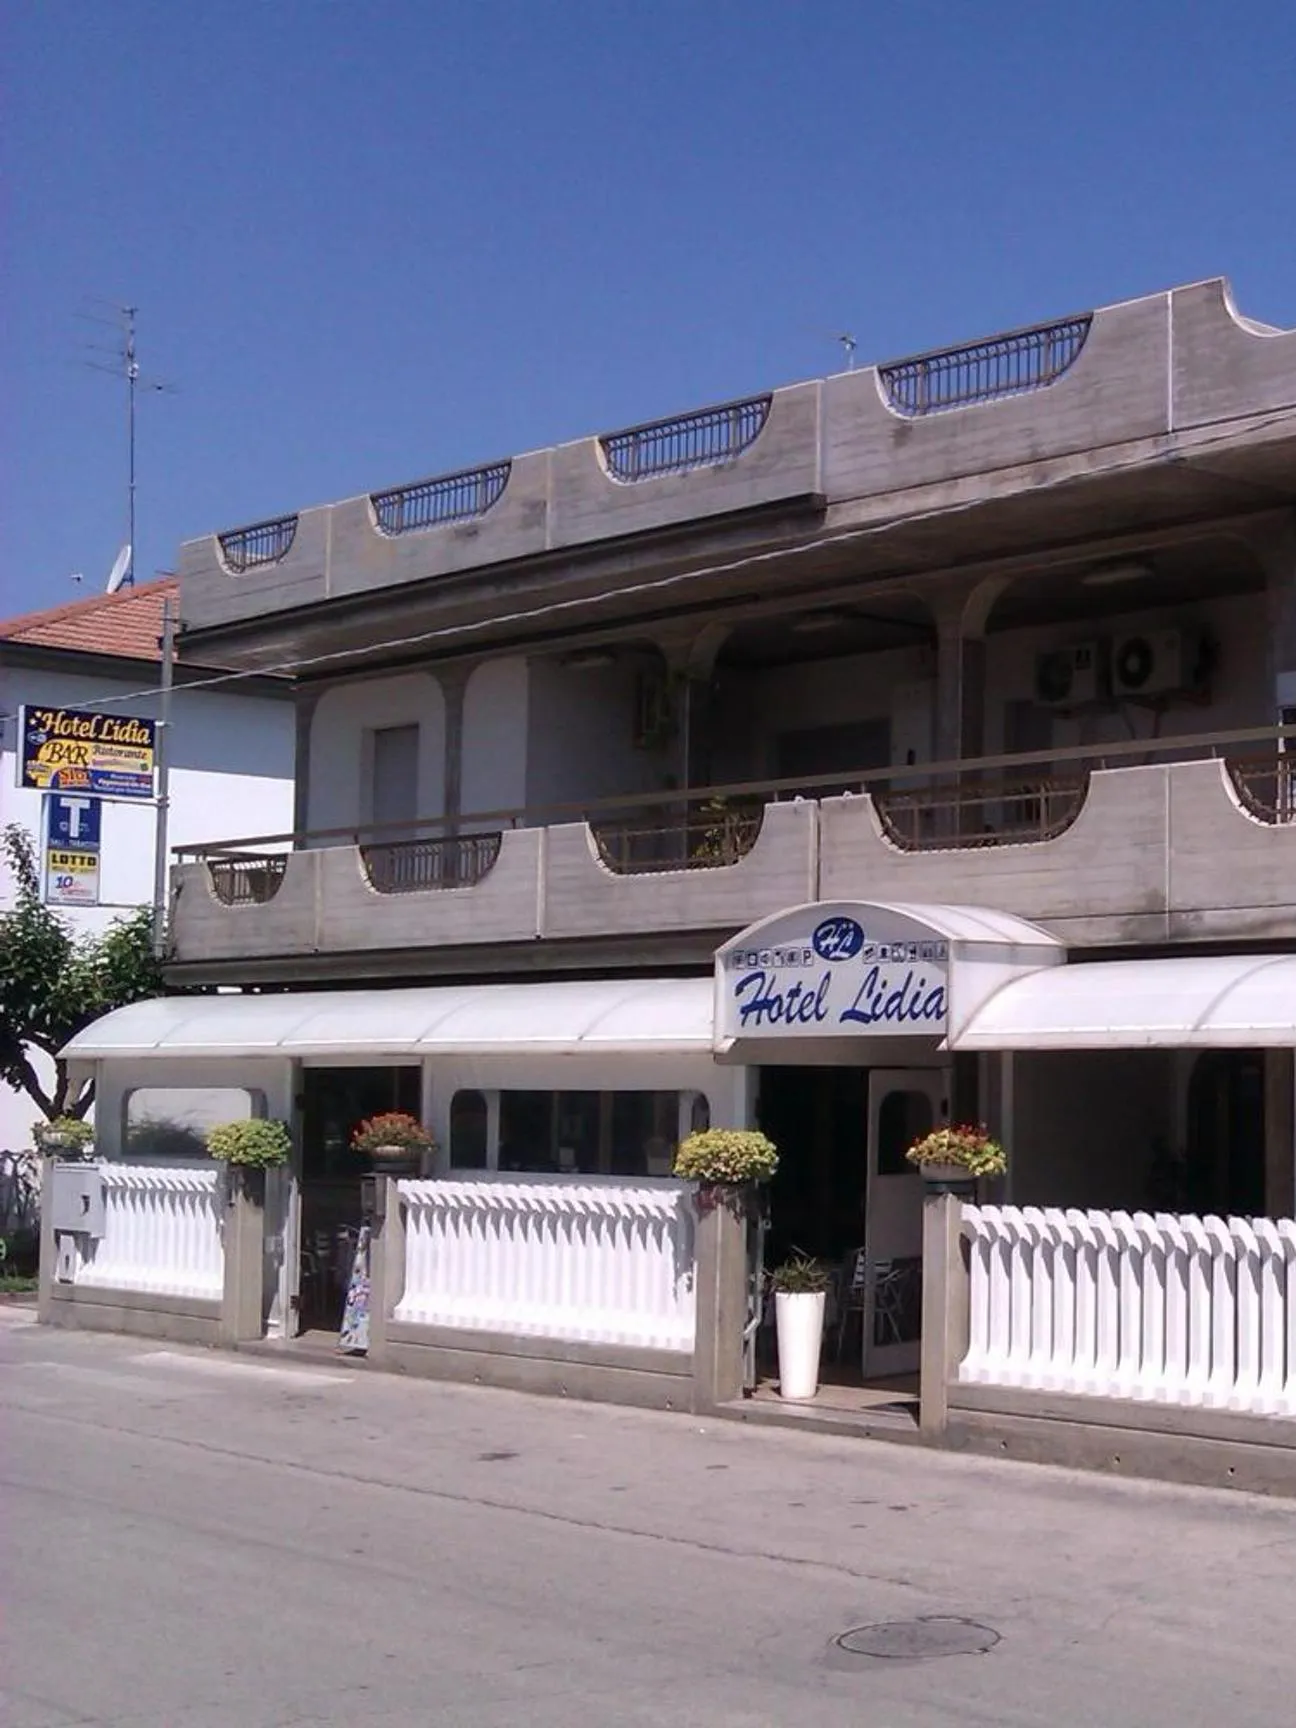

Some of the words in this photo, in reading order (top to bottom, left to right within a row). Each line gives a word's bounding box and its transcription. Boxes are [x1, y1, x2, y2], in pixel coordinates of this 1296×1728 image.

[40, 711, 102, 738] Hotel
[98, 719, 151, 745] Lidia
[45, 742, 89, 766] BAR
[60, 797, 90, 838] T
[52, 853, 97, 867] LOTTO
[56, 875, 74, 889] 10
[735, 971, 831, 1027] Hotel
[840, 966, 948, 1024] Lidia
